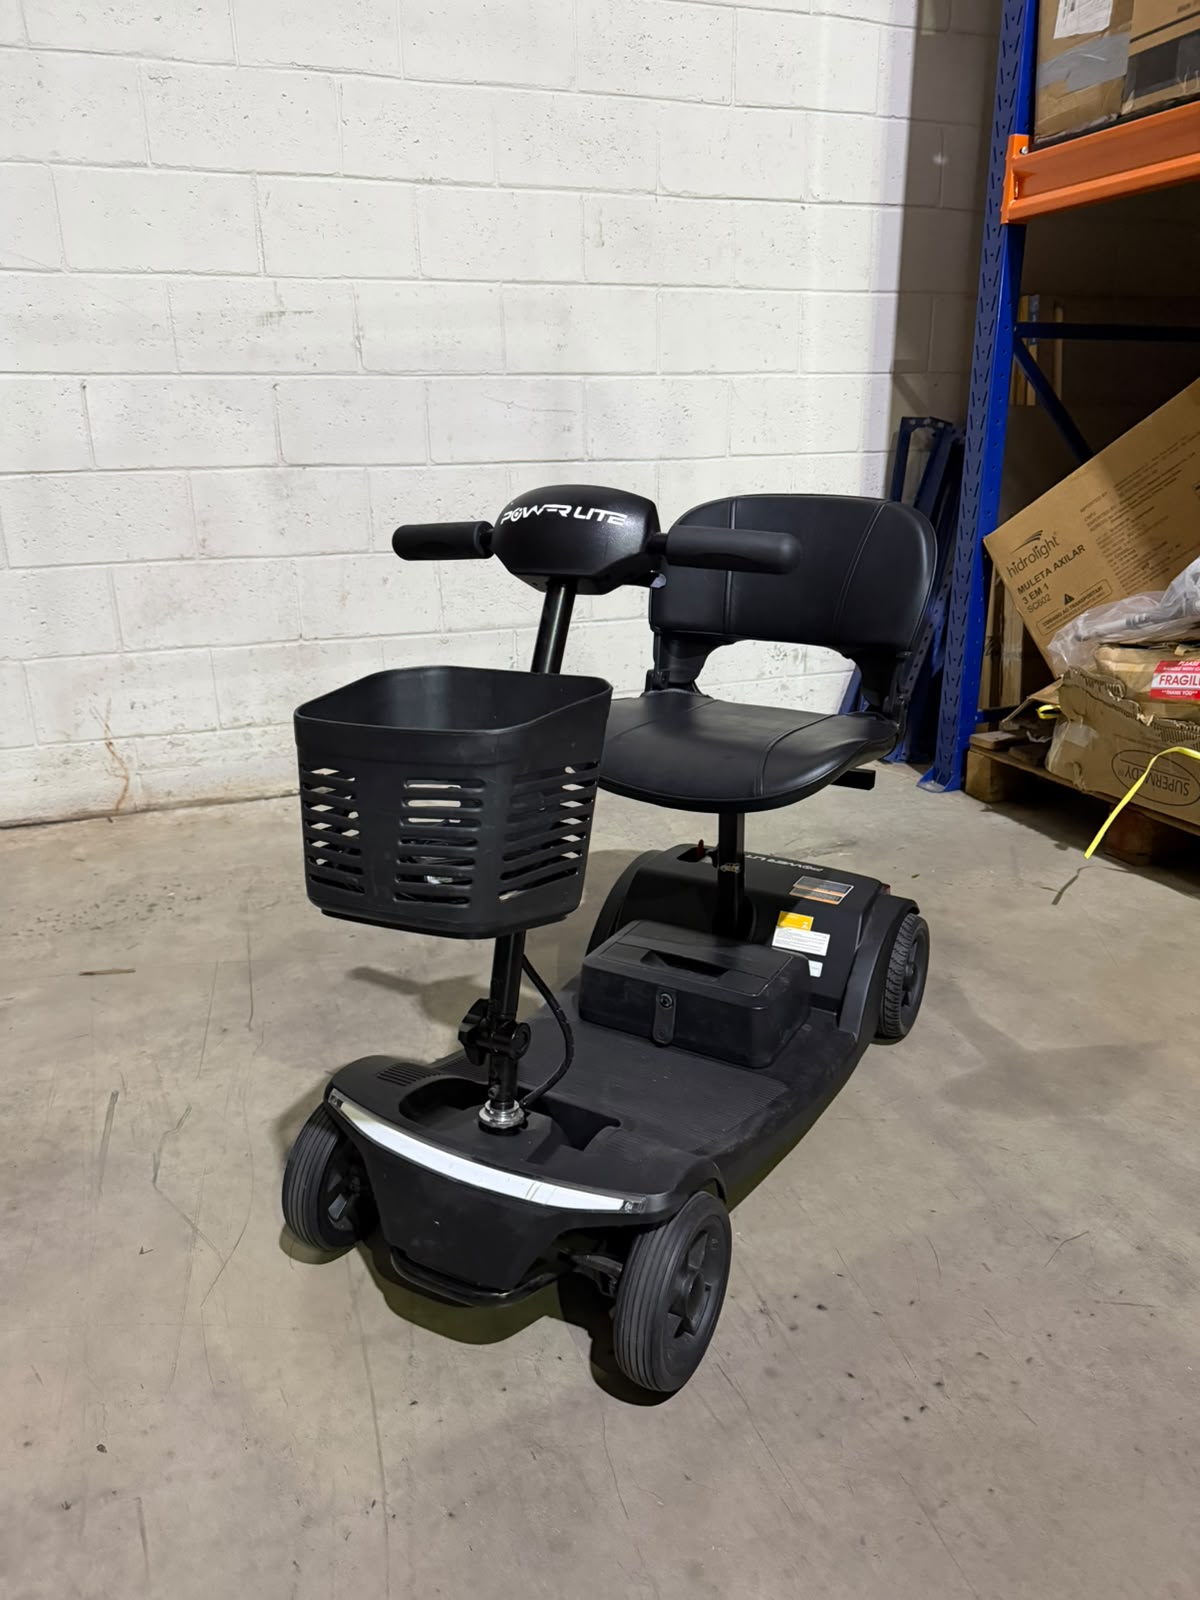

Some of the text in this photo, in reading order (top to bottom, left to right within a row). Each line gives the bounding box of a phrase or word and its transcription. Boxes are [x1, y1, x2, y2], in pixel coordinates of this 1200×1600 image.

[573, 507, 628, 526] LITE
[1006, 536, 1060, 578] hidrolight
[1016, 544, 1086, 594] MULETA AXILAR
[1022, 582, 1050, 605] 3 EM 1
